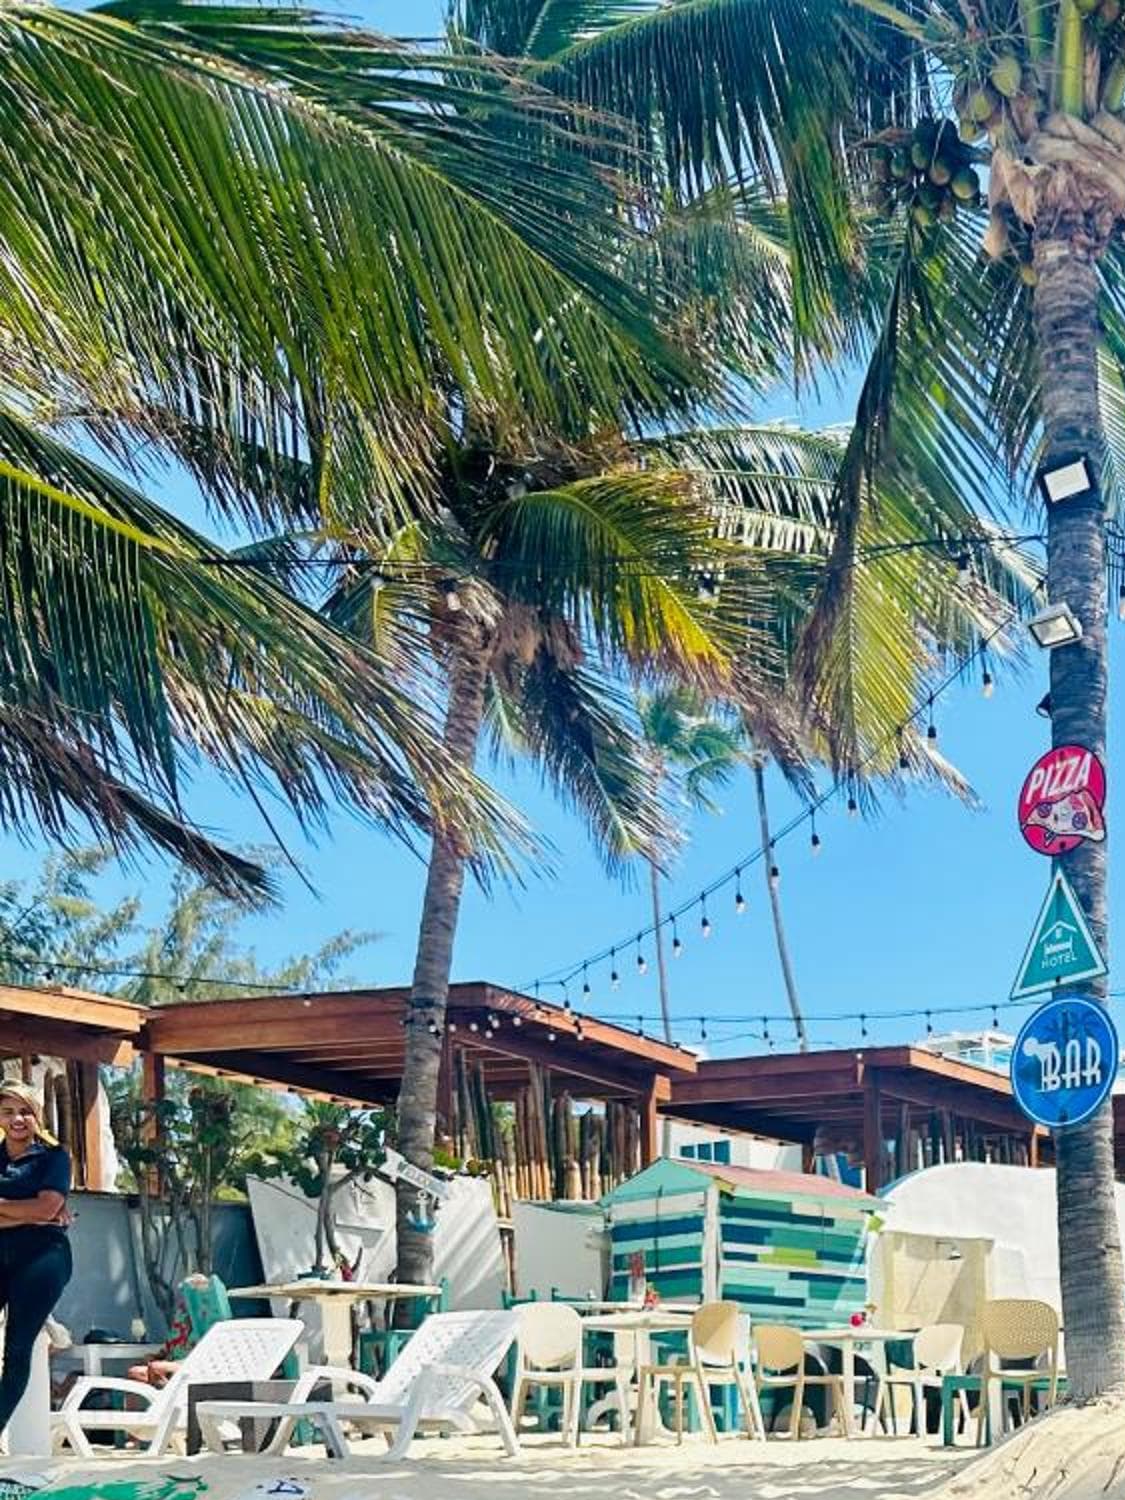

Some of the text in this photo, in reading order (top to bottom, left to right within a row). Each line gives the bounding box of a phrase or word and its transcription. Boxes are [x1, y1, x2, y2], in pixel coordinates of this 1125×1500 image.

[1025, 752, 1091, 804] PIZZA
[1041, 951, 1077, 968] HOTEL
[1043, 1036, 1101, 1091] BAR
